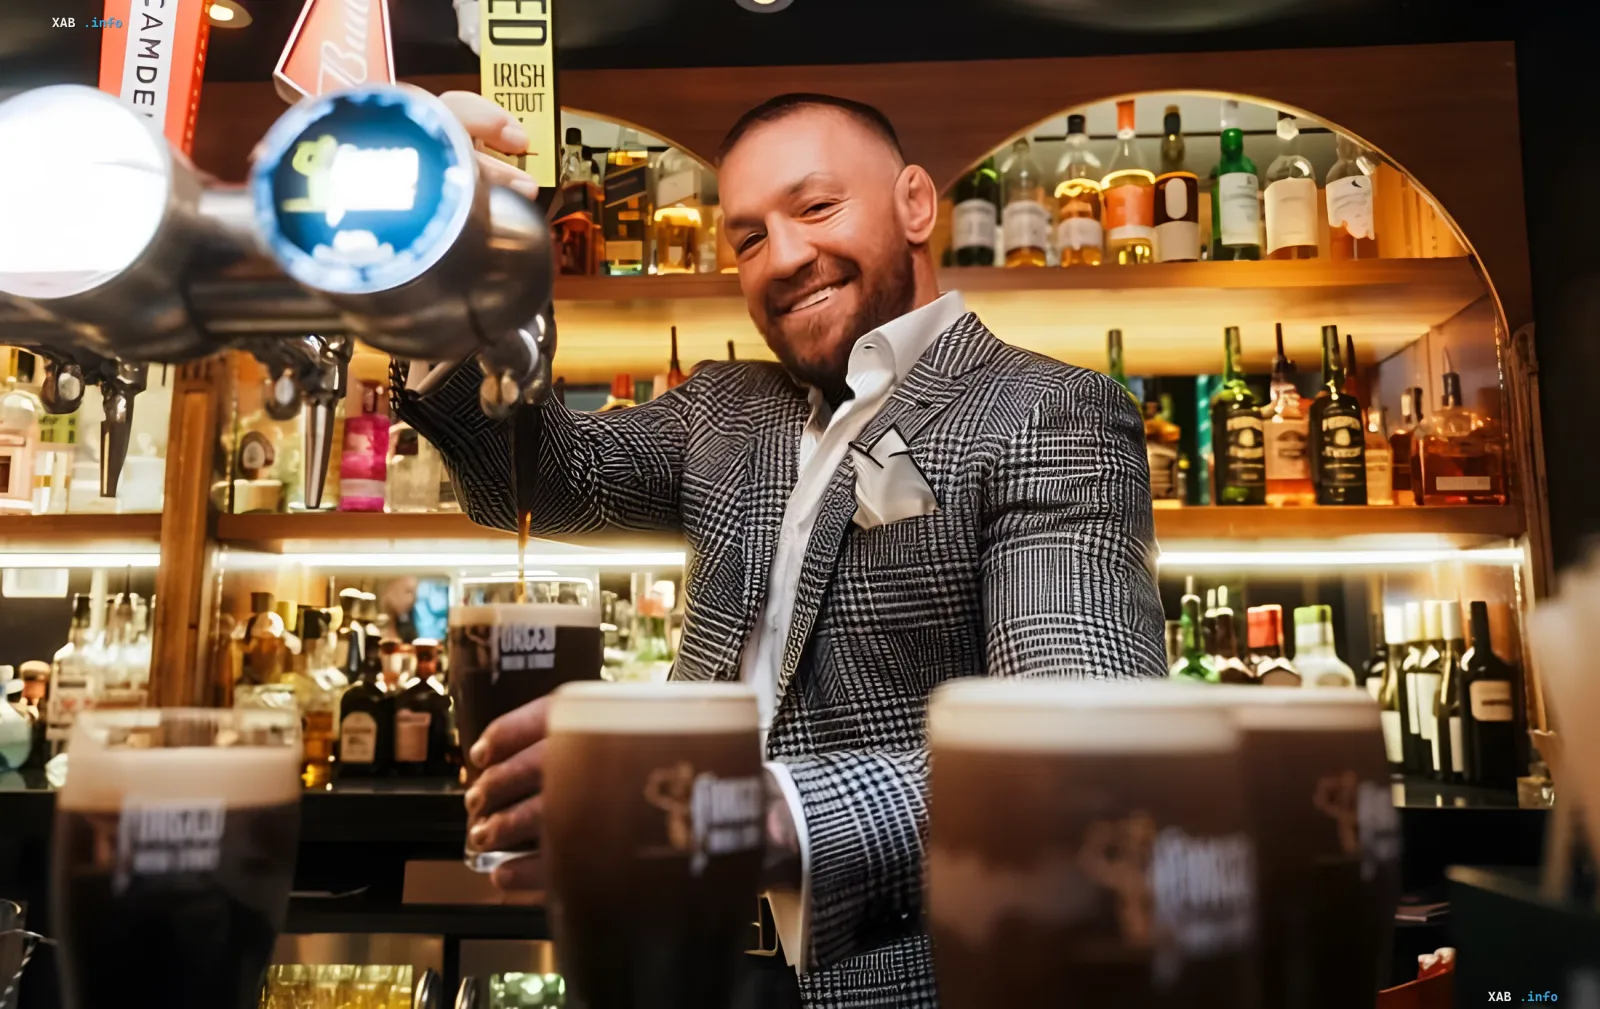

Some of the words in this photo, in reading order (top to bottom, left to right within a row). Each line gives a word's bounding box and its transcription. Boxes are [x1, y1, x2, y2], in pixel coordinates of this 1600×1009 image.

[133, 0, 165, 118] AMDE
[493, 63, 545, 88] IRISH
[494, 92, 545, 113] STOUT
